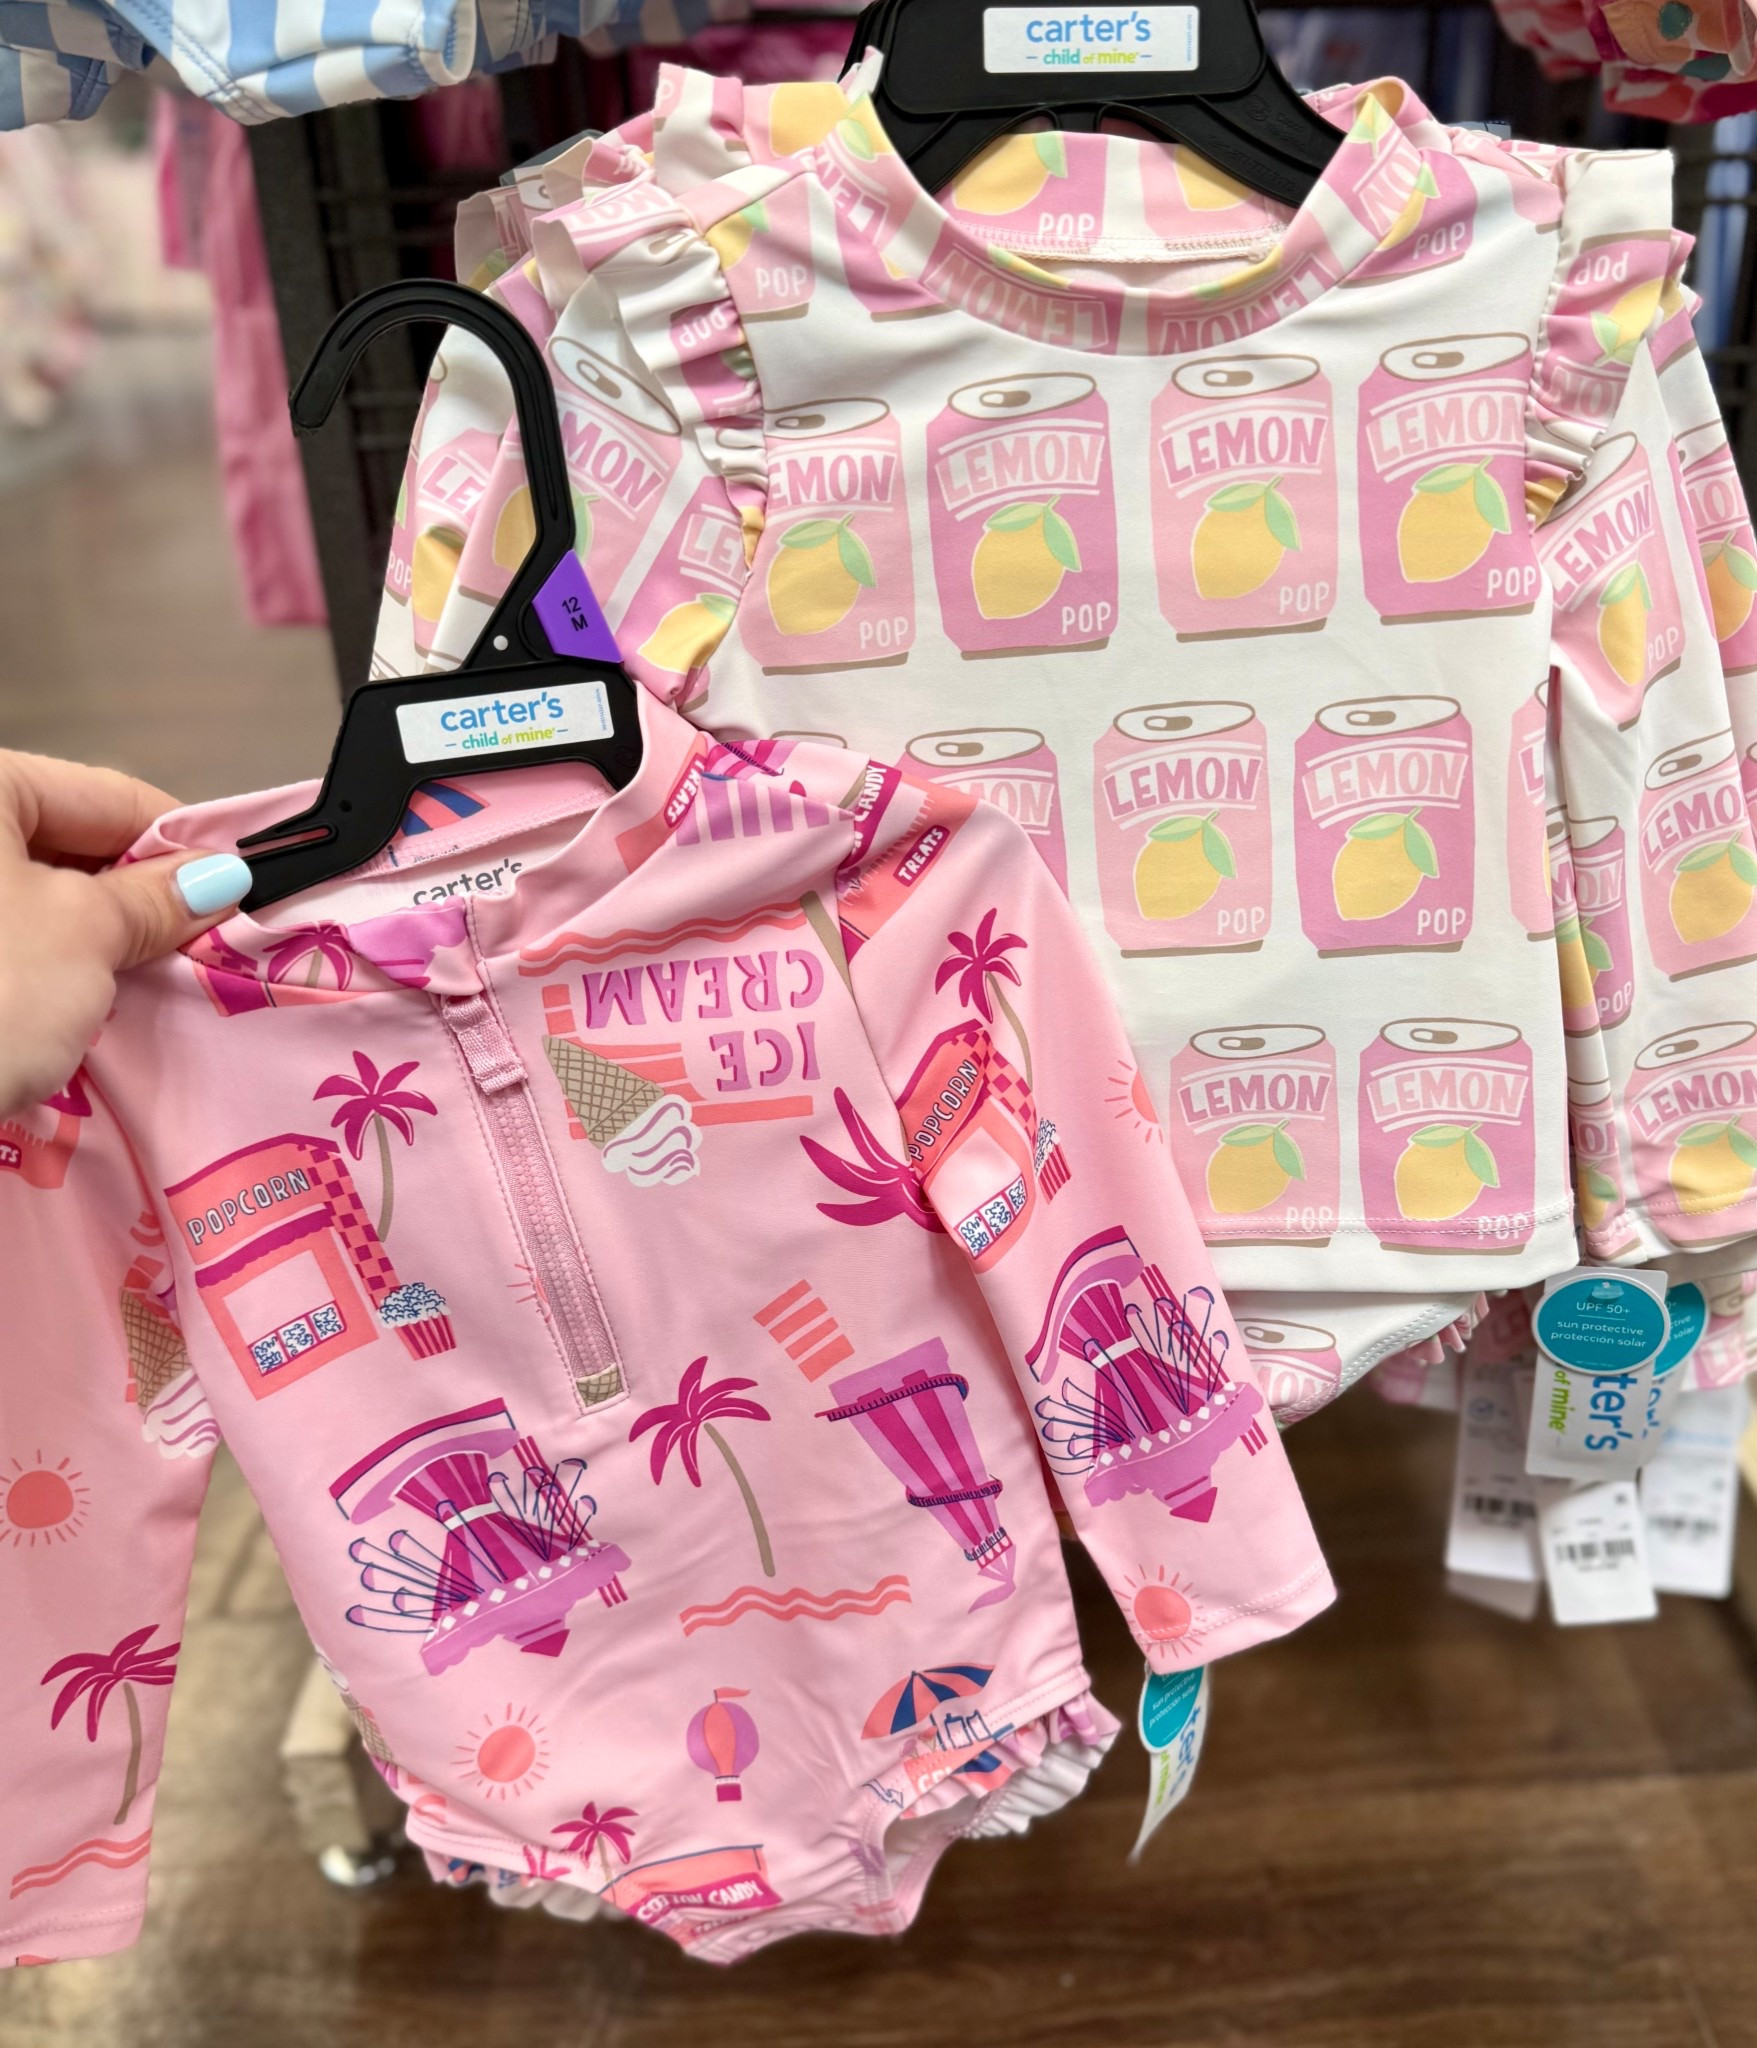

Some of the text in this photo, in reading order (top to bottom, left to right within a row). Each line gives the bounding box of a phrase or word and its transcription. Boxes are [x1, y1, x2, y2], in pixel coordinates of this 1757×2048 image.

[1026, 11, 1151, 42] carter's
[1043, 48, 1136, 65] child of mine
[1039, 213, 1095, 240] POP
[1412, 222, 1465, 260] POP
[755, 266, 808, 299] POP
[1574, 251, 1630, 286] POP
[1369, 394, 1526, 466] LEMON
[560, 410, 664, 510] MON
[937, 433, 1103, 503] LEMON
[1160, 416, 1327, 485] LEMON
[767, 454, 895, 504] EMON
[1279, 581, 1329, 614] POP
[1487, 565, 1536, 599] POP
[562, 597, 582, 614] 12
[571, 615, 589, 632] M
[1062, 602, 1111, 635] POP
[859, 617, 909, 649] POP
[1648, 627, 1679, 665] POP
[440, 691, 564, 732] carter's
[462, 727, 553, 750] child of mine
[1104, 757, 1262, 818] LEMON
[1303, 752, 1467, 814] LEMON
[1643, 784, 1746, 861] LEMO
[899, 828, 944, 882] TREATS
[1217, 906, 1265, 935] POP
[1417, 907, 1466, 935] POP
[582, 949, 824, 1029] CREAM
[1598, 981, 1632, 1018] POP
[709, 1021, 821, 1092] ICE
[906, 1060, 979, 1162] POPCORN
[1179, 1073, 1331, 1124] LEMON
[1368, 1069, 1526, 1119] LEMON
[186, 1168, 311, 1246] POPCORN
[1286, 1206, 1332, 1230] POP
[1478, 1213, 1528, 1240] POP
[1576, 1301, 1631, 1314] UPF 50+
[1551, 1331, 1647, 1348] protección solar
[1557, 1320, 1644, 1336] sun protective
[1549, 1370, 1571, 1431] of mine
[1584, 1373, 1638, 1450] ter's
[708, 1879, 764, 1906] CANDY
